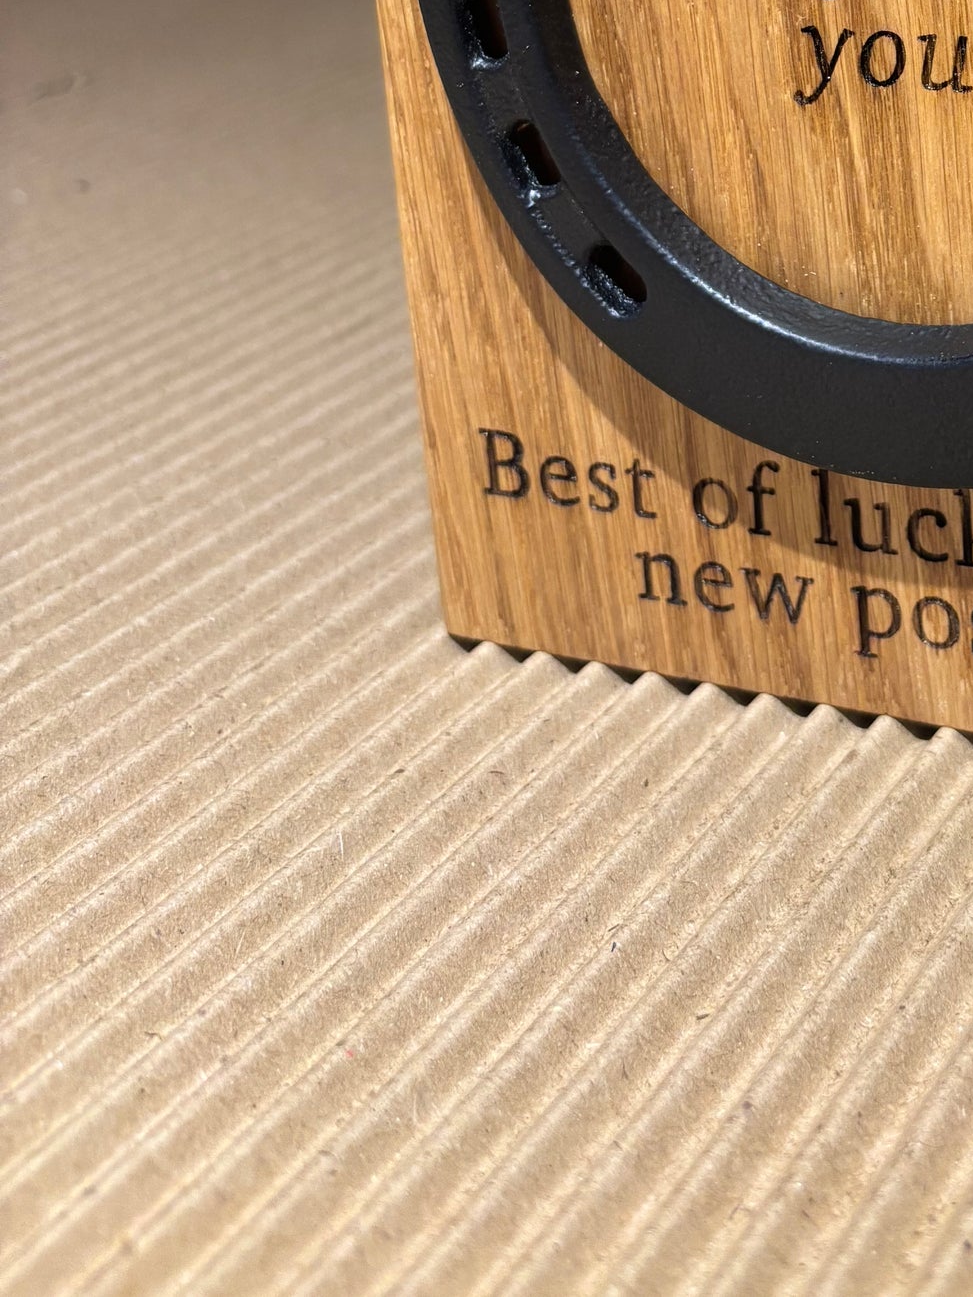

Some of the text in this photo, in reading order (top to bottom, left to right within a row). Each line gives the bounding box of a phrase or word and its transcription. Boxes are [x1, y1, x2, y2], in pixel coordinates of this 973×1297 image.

[478, 427, 657, 519] Best
[693, 460, 780, 536] of
[635, 551, 814, 624] new
